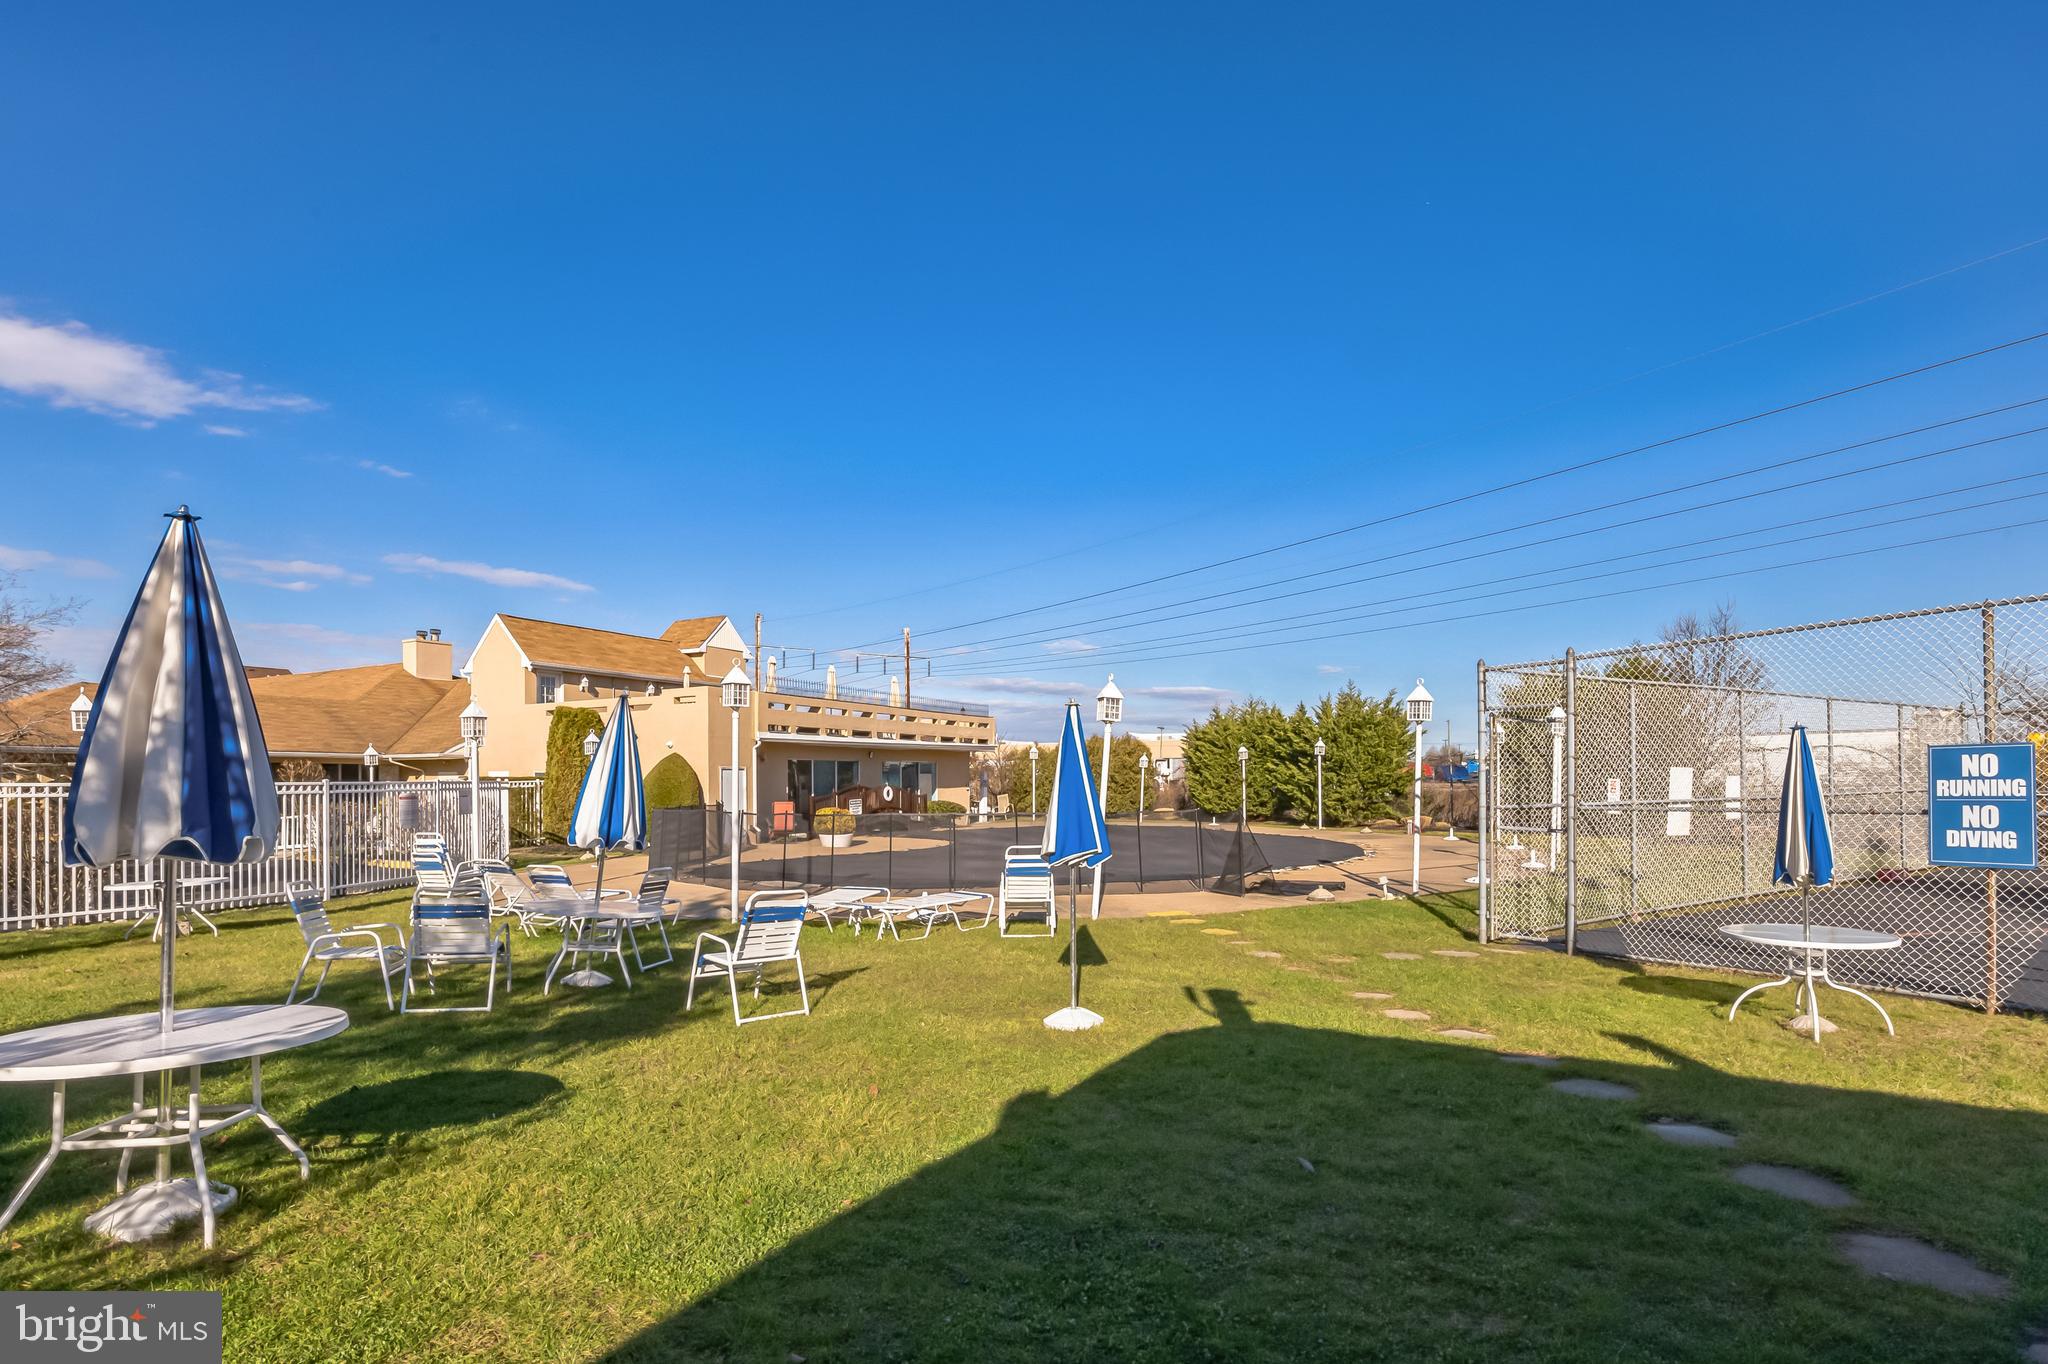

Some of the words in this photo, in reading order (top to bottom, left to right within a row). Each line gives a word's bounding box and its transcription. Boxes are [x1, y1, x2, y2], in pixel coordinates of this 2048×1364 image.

[1961, 753, 1999, 777] NO
[1936, 778, 2027, 797] RUNNING
[1962, 805, 2000, 829] NO
[1946, 829, 2017, 849] DIVING
